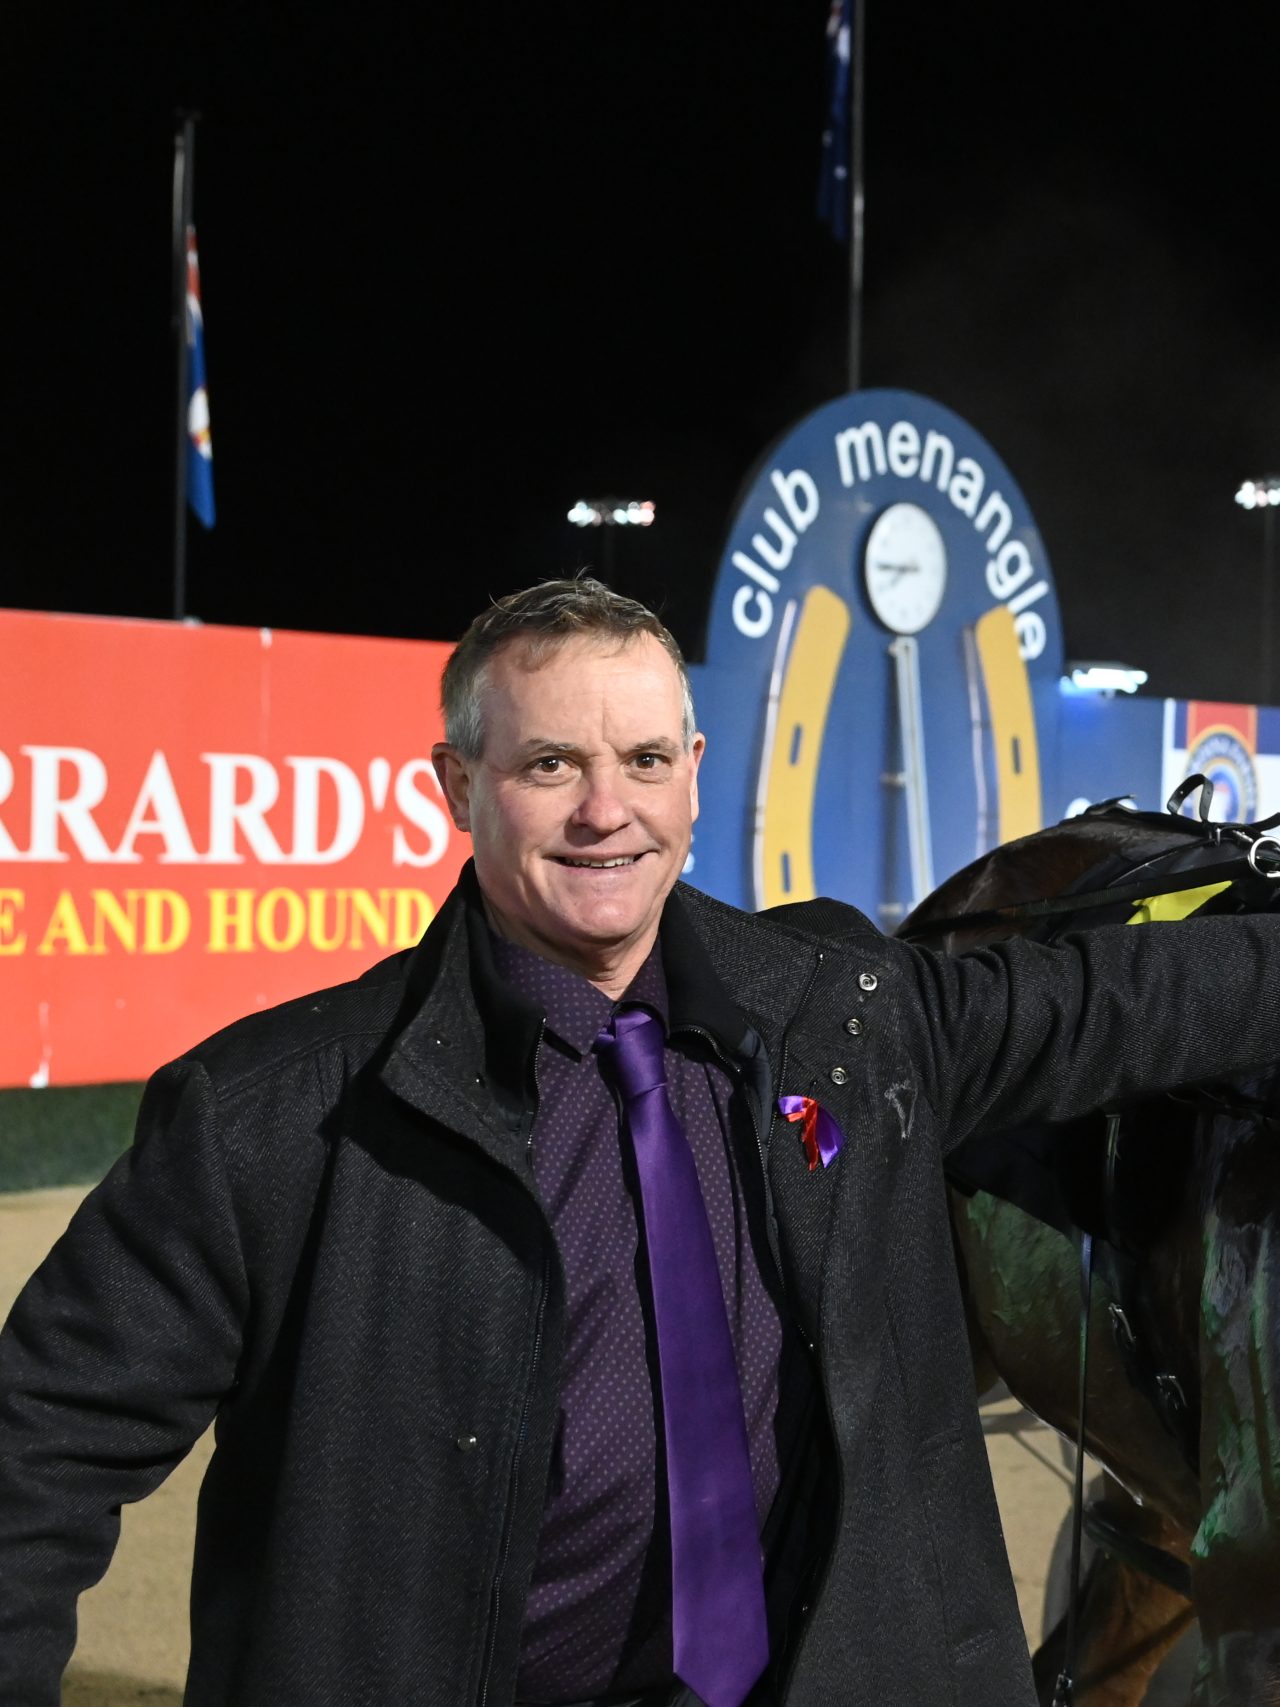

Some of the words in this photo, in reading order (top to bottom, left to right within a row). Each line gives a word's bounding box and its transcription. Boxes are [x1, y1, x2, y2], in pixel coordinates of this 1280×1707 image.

[731, 468, 820, 639] club
[835, 420, 1050, 661] menangle
[0, 744, 450, 869] RARD'S
[38, 889, 192, 957] AND
[206, 887, 437, 954] HOUND
